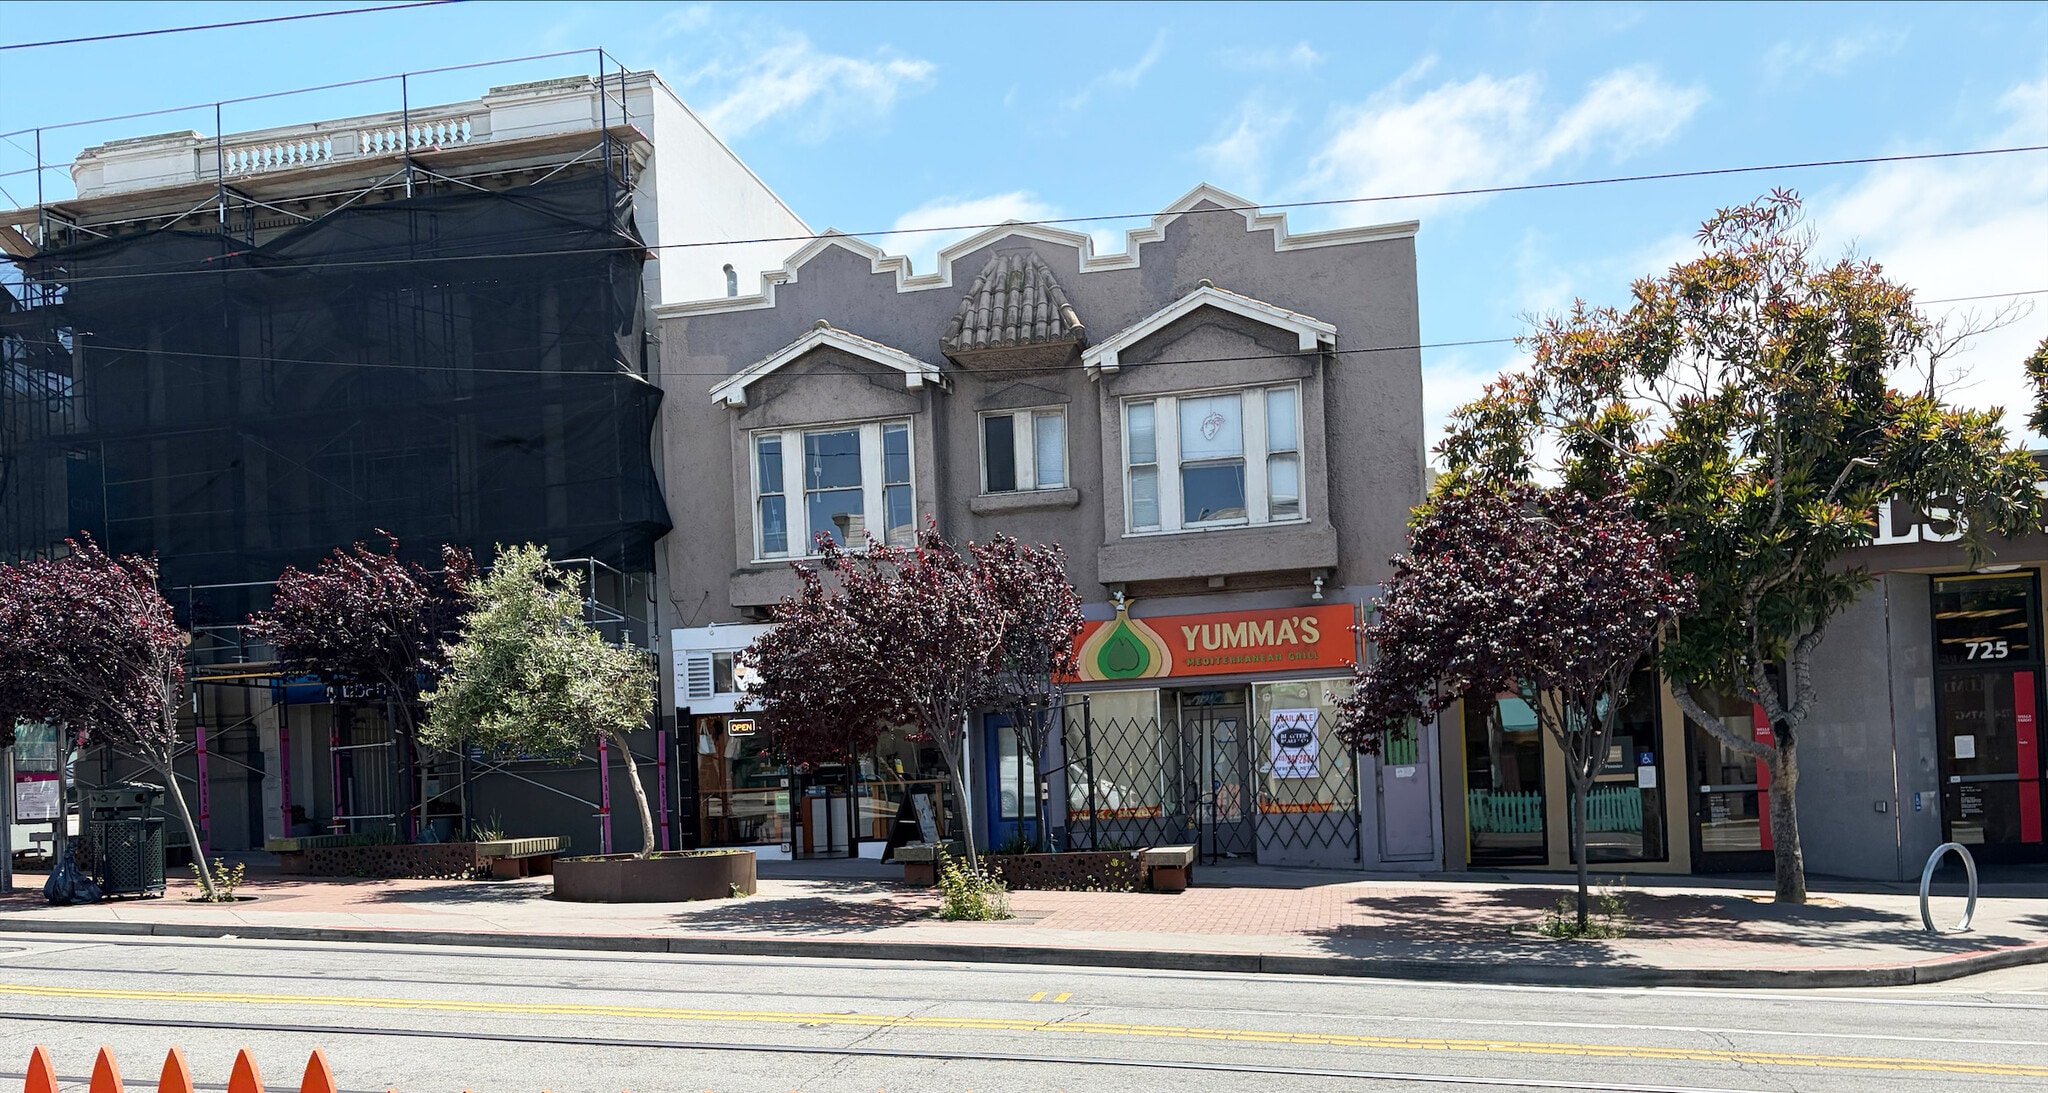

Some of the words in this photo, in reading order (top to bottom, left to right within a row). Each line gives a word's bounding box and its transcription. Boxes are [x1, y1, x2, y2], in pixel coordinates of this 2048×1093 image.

[1181, 616, 1321, 651] YUMMA'S
[1186, 653, 1283, 667] MEDITERRANEAN
[1288, 651, 1319, 661] GRILL
[1965, 641, 2008, 660] 725
[731, 723, 753, 732] OPEN
